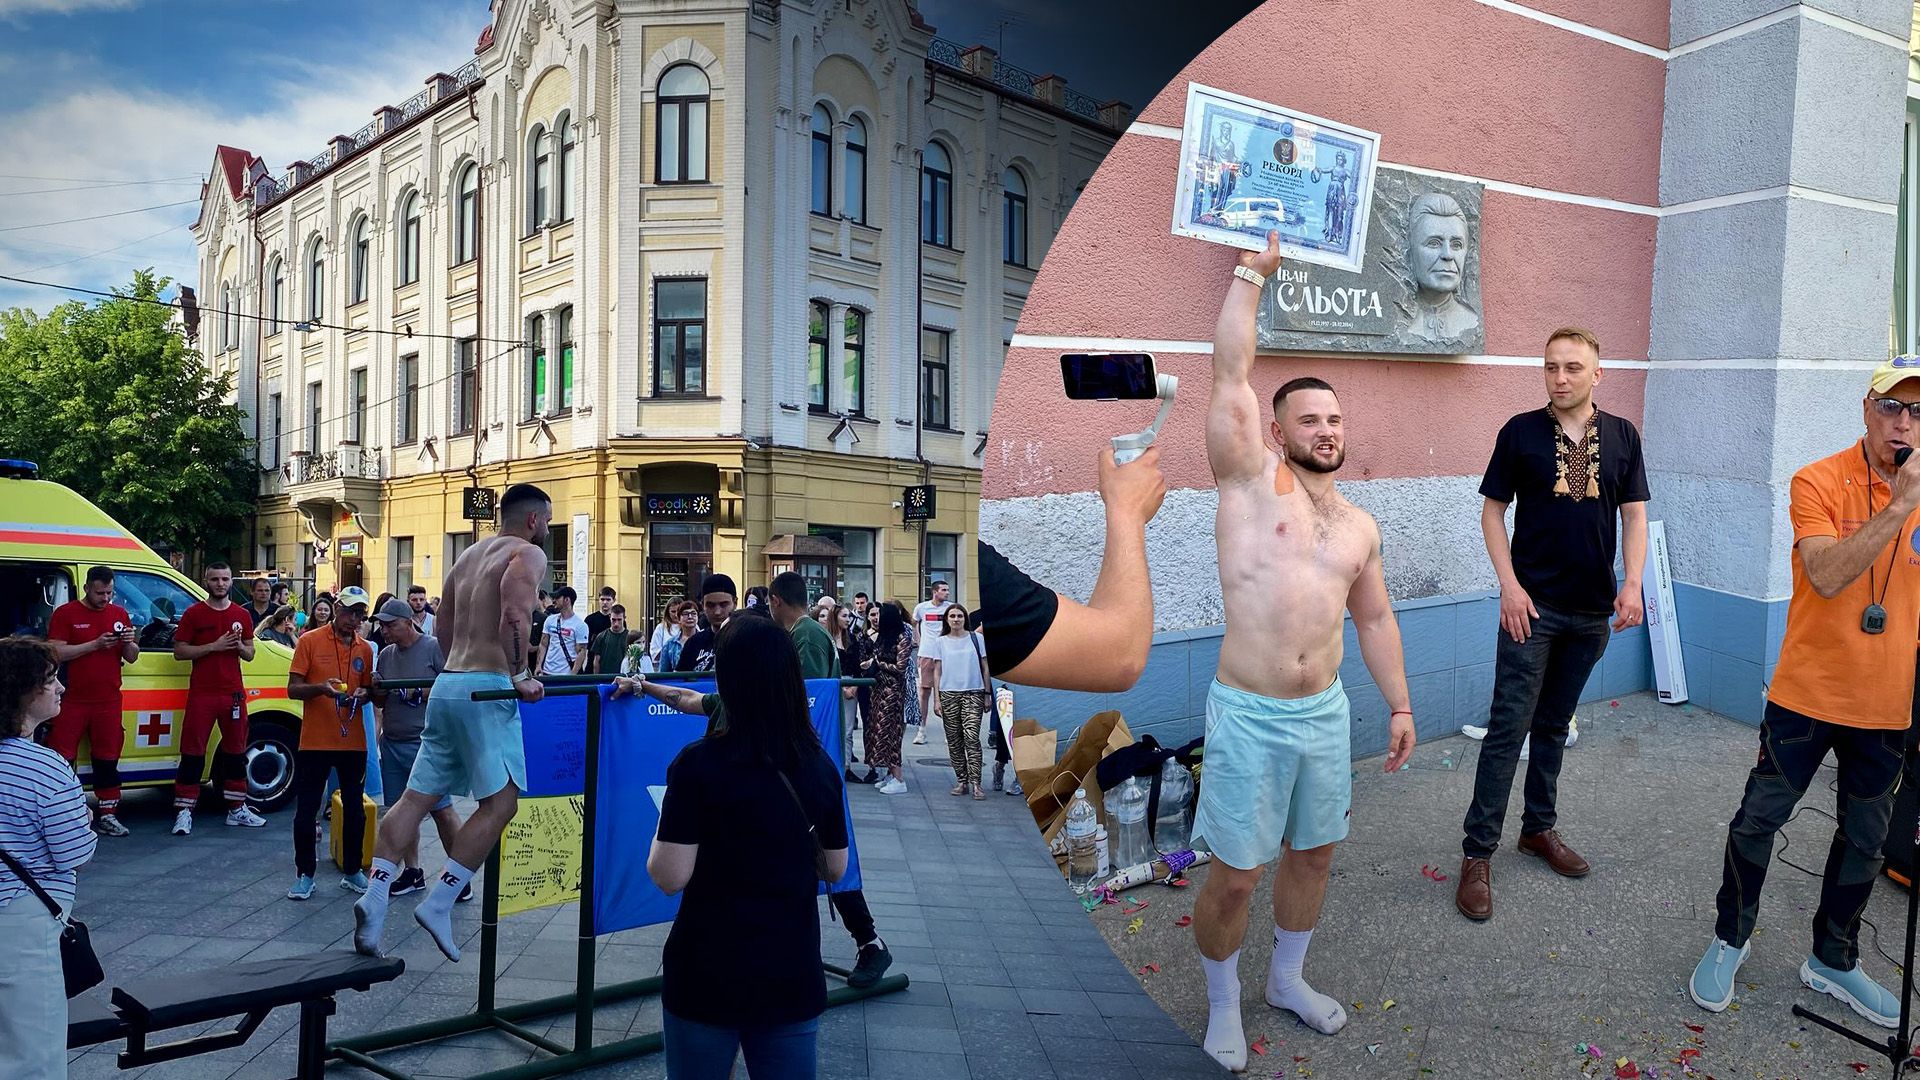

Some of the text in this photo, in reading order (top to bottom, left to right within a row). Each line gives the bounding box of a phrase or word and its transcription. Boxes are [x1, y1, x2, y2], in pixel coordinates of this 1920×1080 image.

[1262, 160, 1303, 180] РЕКОРД
[1276, 265, 1308, 283] ІВАН
[1276, 282, 1383, 318] СЛЬОТА
[648, 498, 691, 509] Goodki
